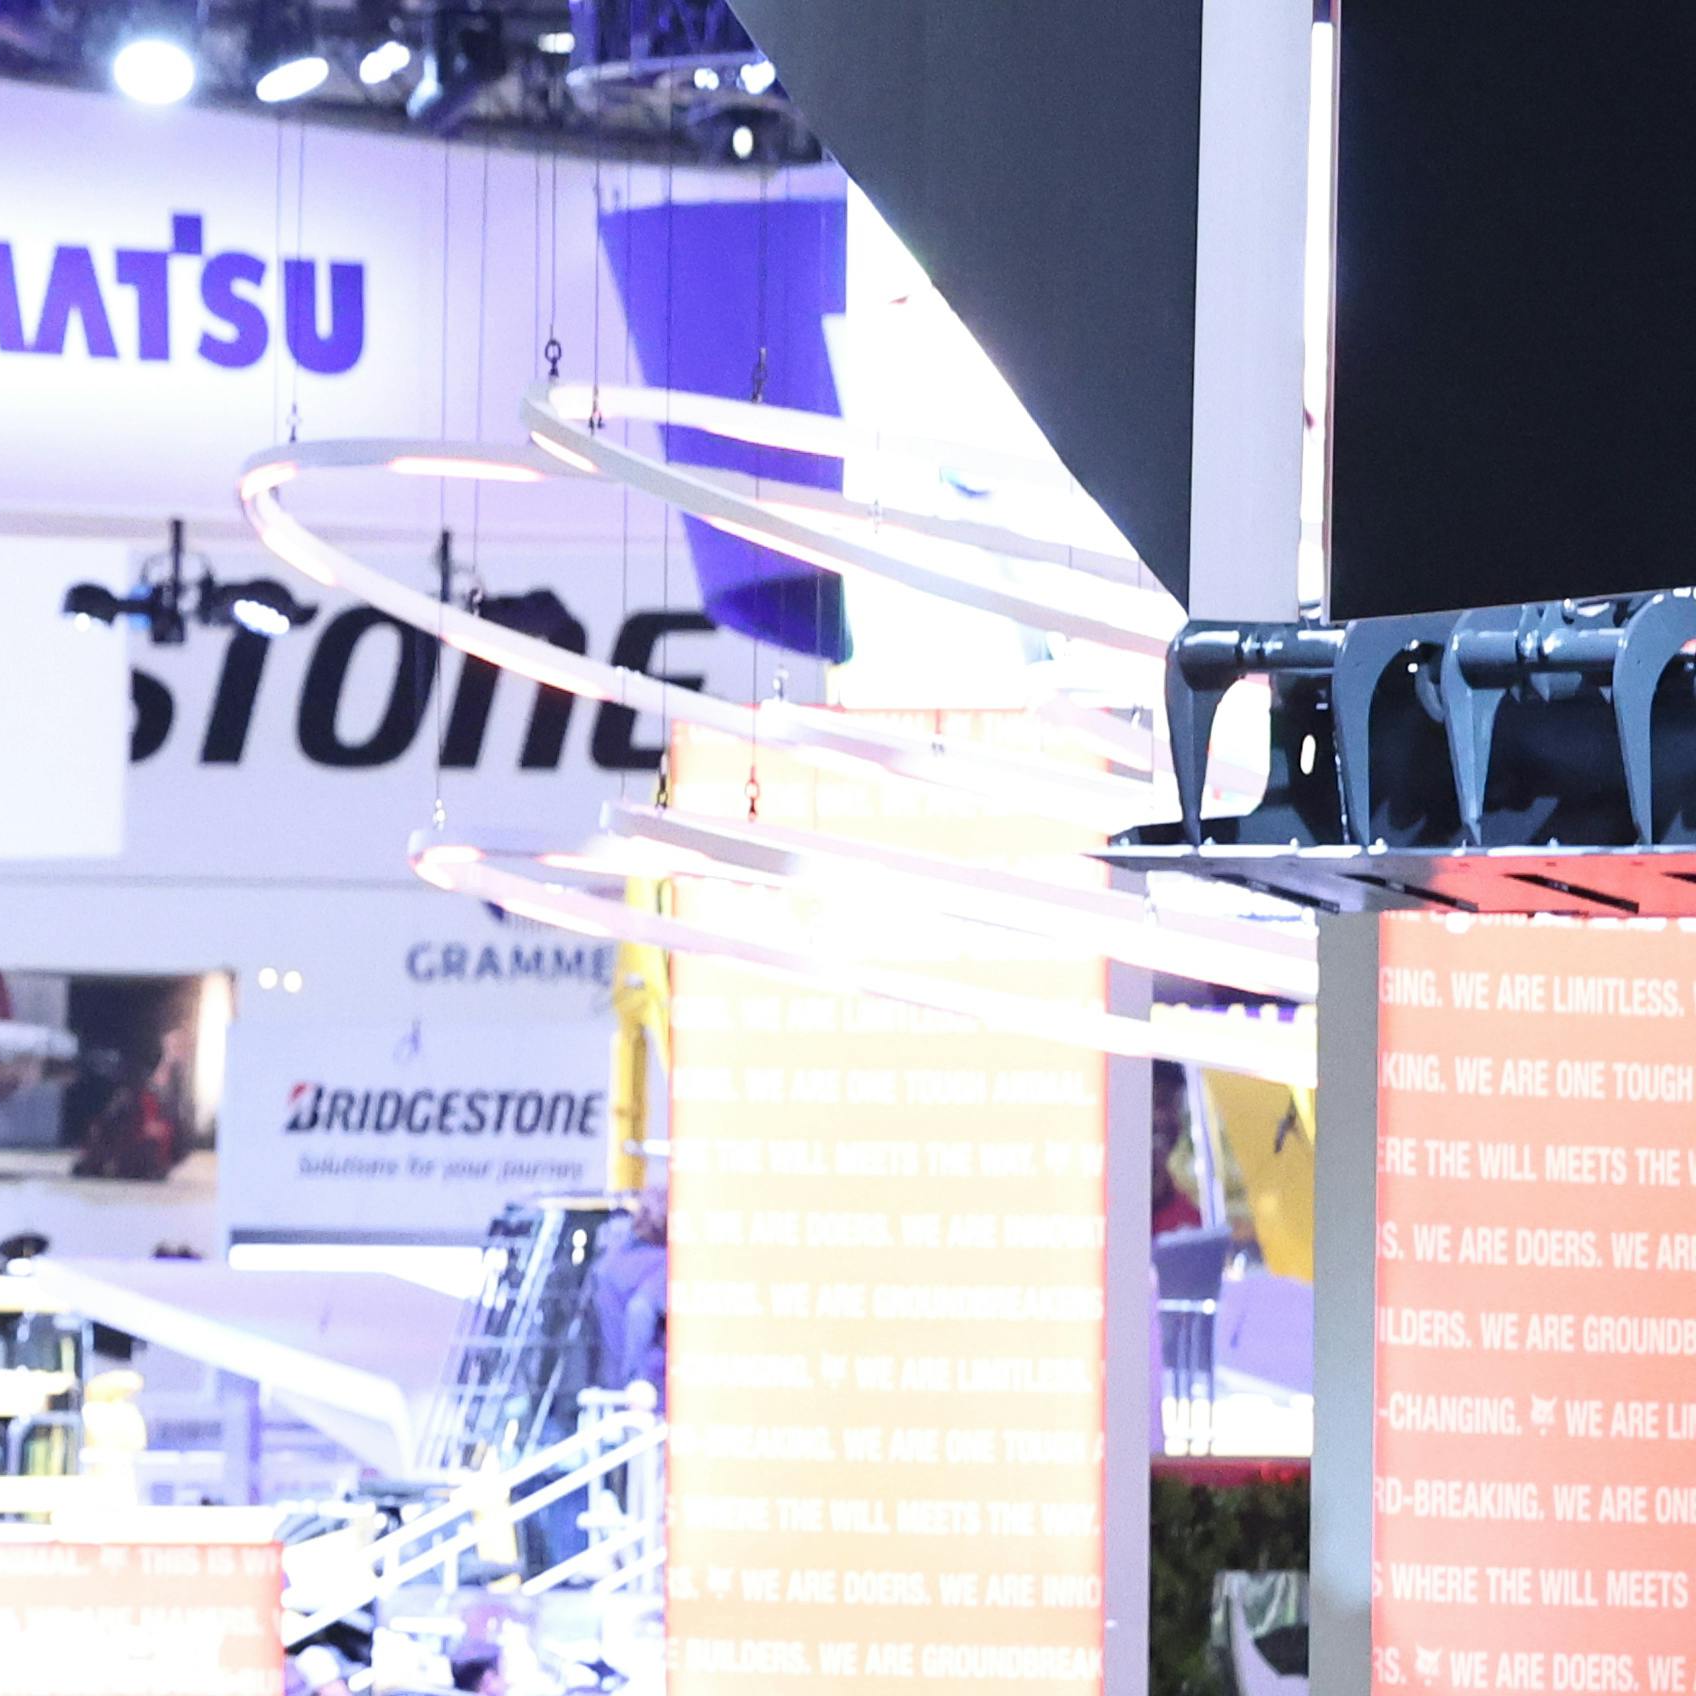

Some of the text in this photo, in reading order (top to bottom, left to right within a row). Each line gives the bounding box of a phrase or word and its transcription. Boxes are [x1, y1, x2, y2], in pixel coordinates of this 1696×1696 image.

[1451, 972, 1489, 1010] WE
[1497, 974, 1546, 1012] ARE
[1553, 976, 1685, 1017] LIMITLESS.
[1455, 1057, 1493, 1095] WE
[1500, 1059, 1550, 1097] ARE
[1556, 1061, 1606, 1099] ONE
[1613, 1062, 1693, 1102] TOUGH
[285, 1082, 605, 1136] BRIDGESTONE
[1424, 1139, 1681, 1186] THE WILL MEETS THE
[1413, 1223, 1649, 1269] WE ARE DOERS. WE
[1480, 1311, 1520, 1351] WE
[1526, 1313, 1575, 1352] ARE
[1565, 1399, 1604, 1438] WE
[1610, 1401, 1658, 1439] ARE
[776, 1497, 824, 1533] THE
[828, 1498, 891, 1533] WILL
[896, 1500, 981, 1535] MEETS
[988, 1502, 1036, 1536] THE
[1553, 1484, 1591, 1522] WE
[1598, 1485, 1648, 1524] ARE
[741, 1568, 781, 1602] WE
[787, 1569, 837, 1603] ARE
[843, 1570, 932, 1604] DOERS.
[939, 1572, 979, 1605] WE
[985, 1573, 1036, 1606] ARE
[1391, 1563, 1689, 1610] WHERE THE WILL MEETS
[818, 1641, 857, 1675] WE
[864, 1642, 915, 1676] ARE
[1450, 1650, 1686, 1693] WE ARE DOERS. WE
